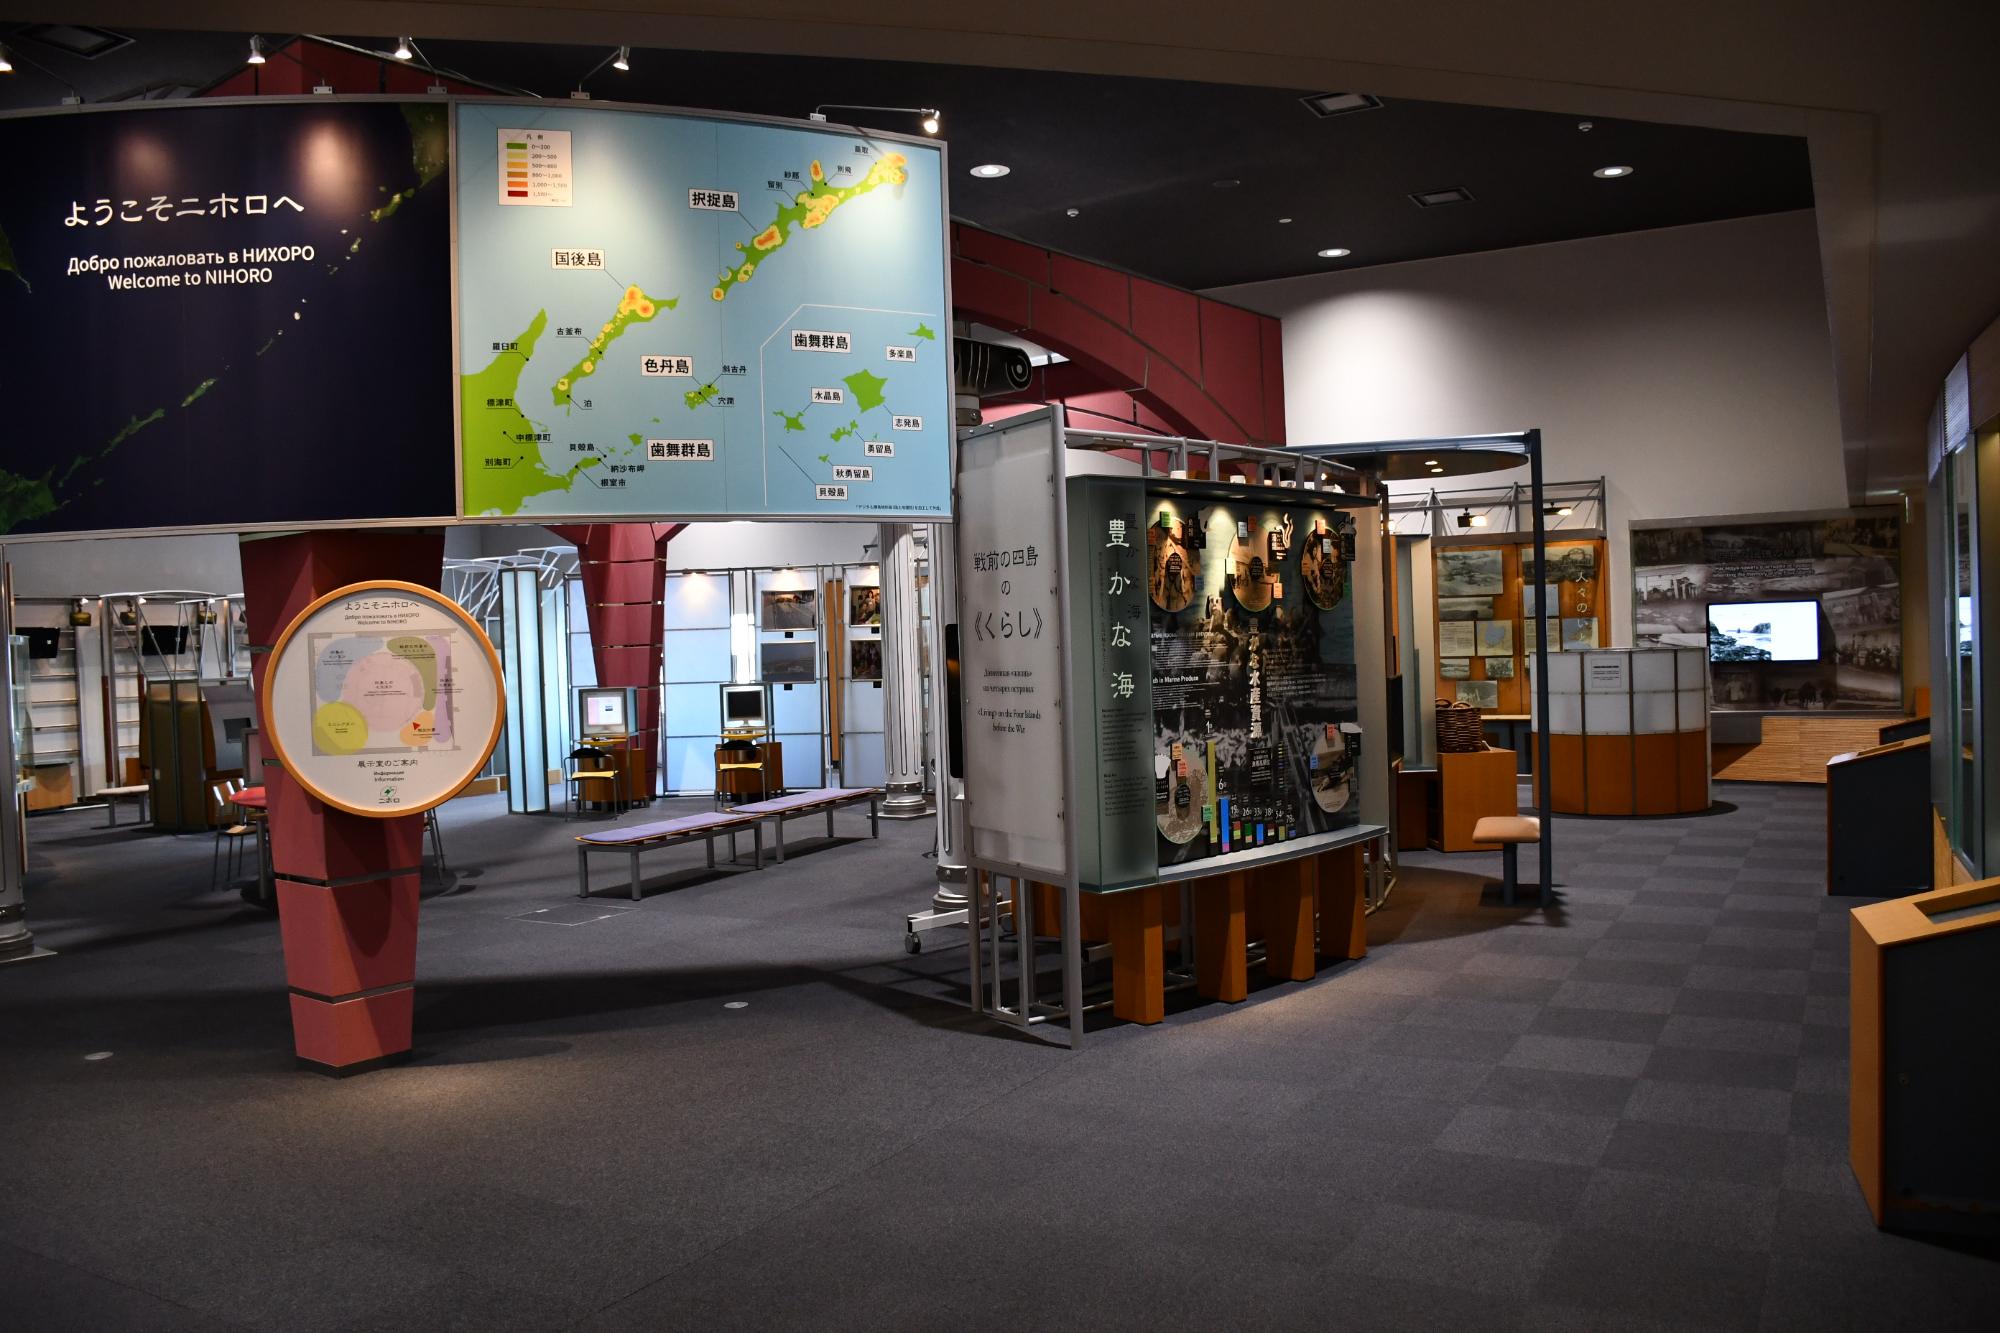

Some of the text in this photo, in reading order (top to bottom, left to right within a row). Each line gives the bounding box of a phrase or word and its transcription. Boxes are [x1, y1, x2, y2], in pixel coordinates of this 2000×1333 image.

[64, 192, 304, 227] ようこそニホロへ
[67, 245, 315, 275] Добро пожаловать в НИХОРО
[555, 251, 601, 267] 国後島
[107, 268, 273, 290] Welcome to NIHORO
[794, 333, 849, 350] 歯舞群島
[644, 358, 690, 374] 色丹島
[650, 442, 711, 458] 歯舞群島
[973, 545, 1039, 573] 戦前の四島
[1000, 580, 1011, 596] の
[1105, 518, 1136, 700] 豊かな海
